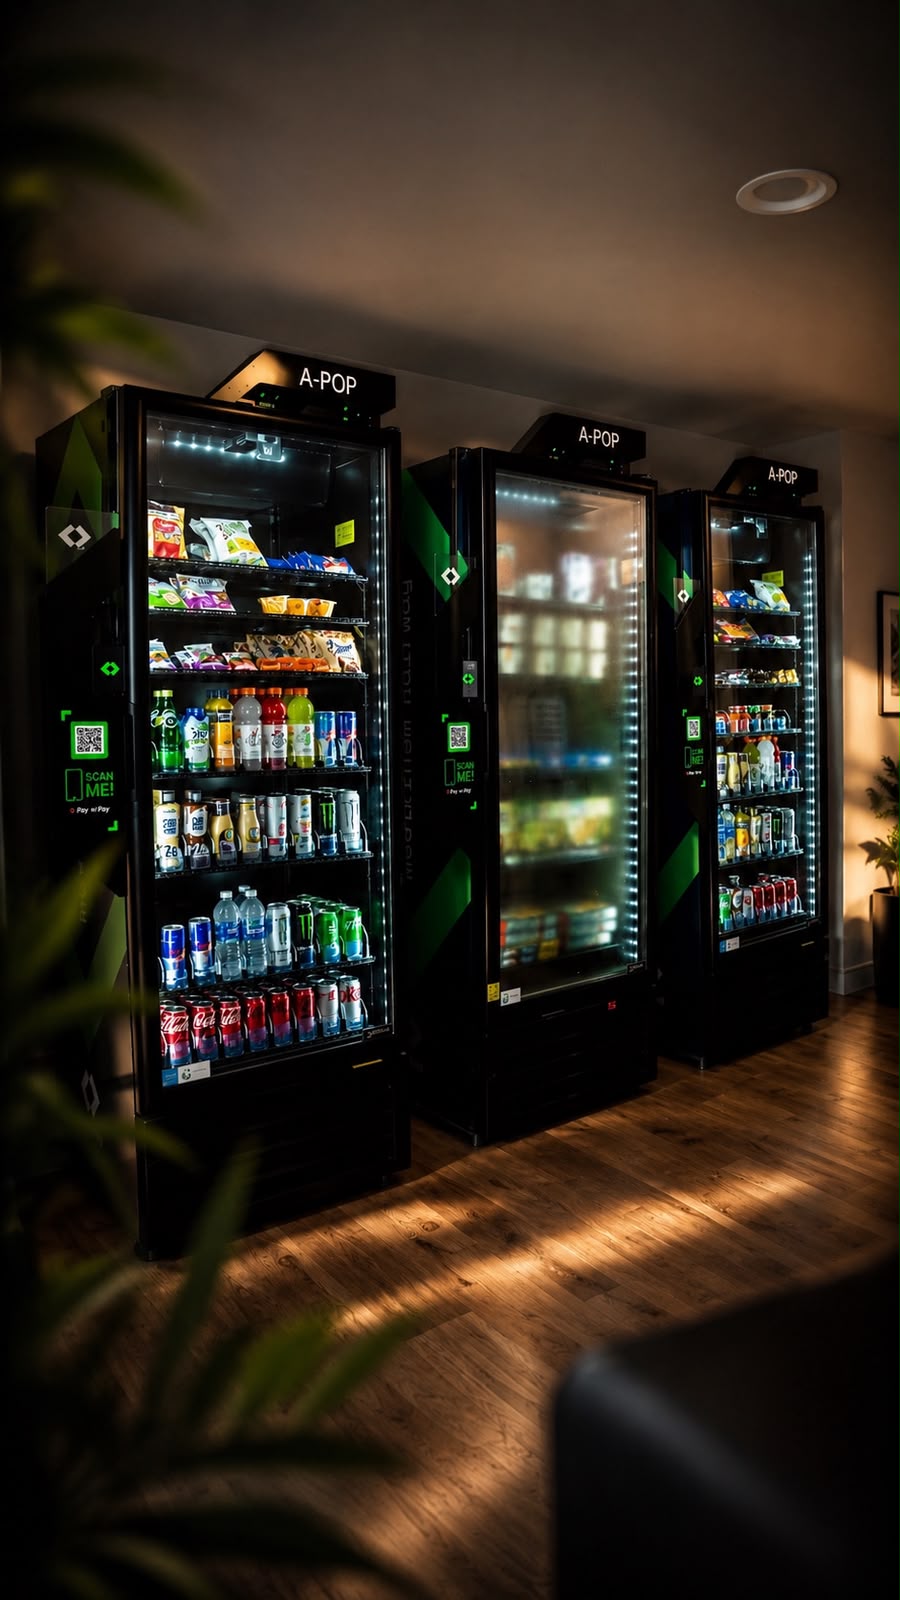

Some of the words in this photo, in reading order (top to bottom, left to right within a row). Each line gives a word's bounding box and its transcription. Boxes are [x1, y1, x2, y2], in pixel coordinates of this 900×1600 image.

[299, 367, 357, 395] A-POP
[578, 426, 620, 448] A-POP
[768, 466, 798, 485] A-POP
[457, 761, 475, 770] SCAN
[85, 771, 114, 782] SCAN
[457, 770, 475, 782] ME!
[85, 782, 114, 798] ME!
[76, 806, 89, 815] Pay
[97, 805, 111, 814] Pay
